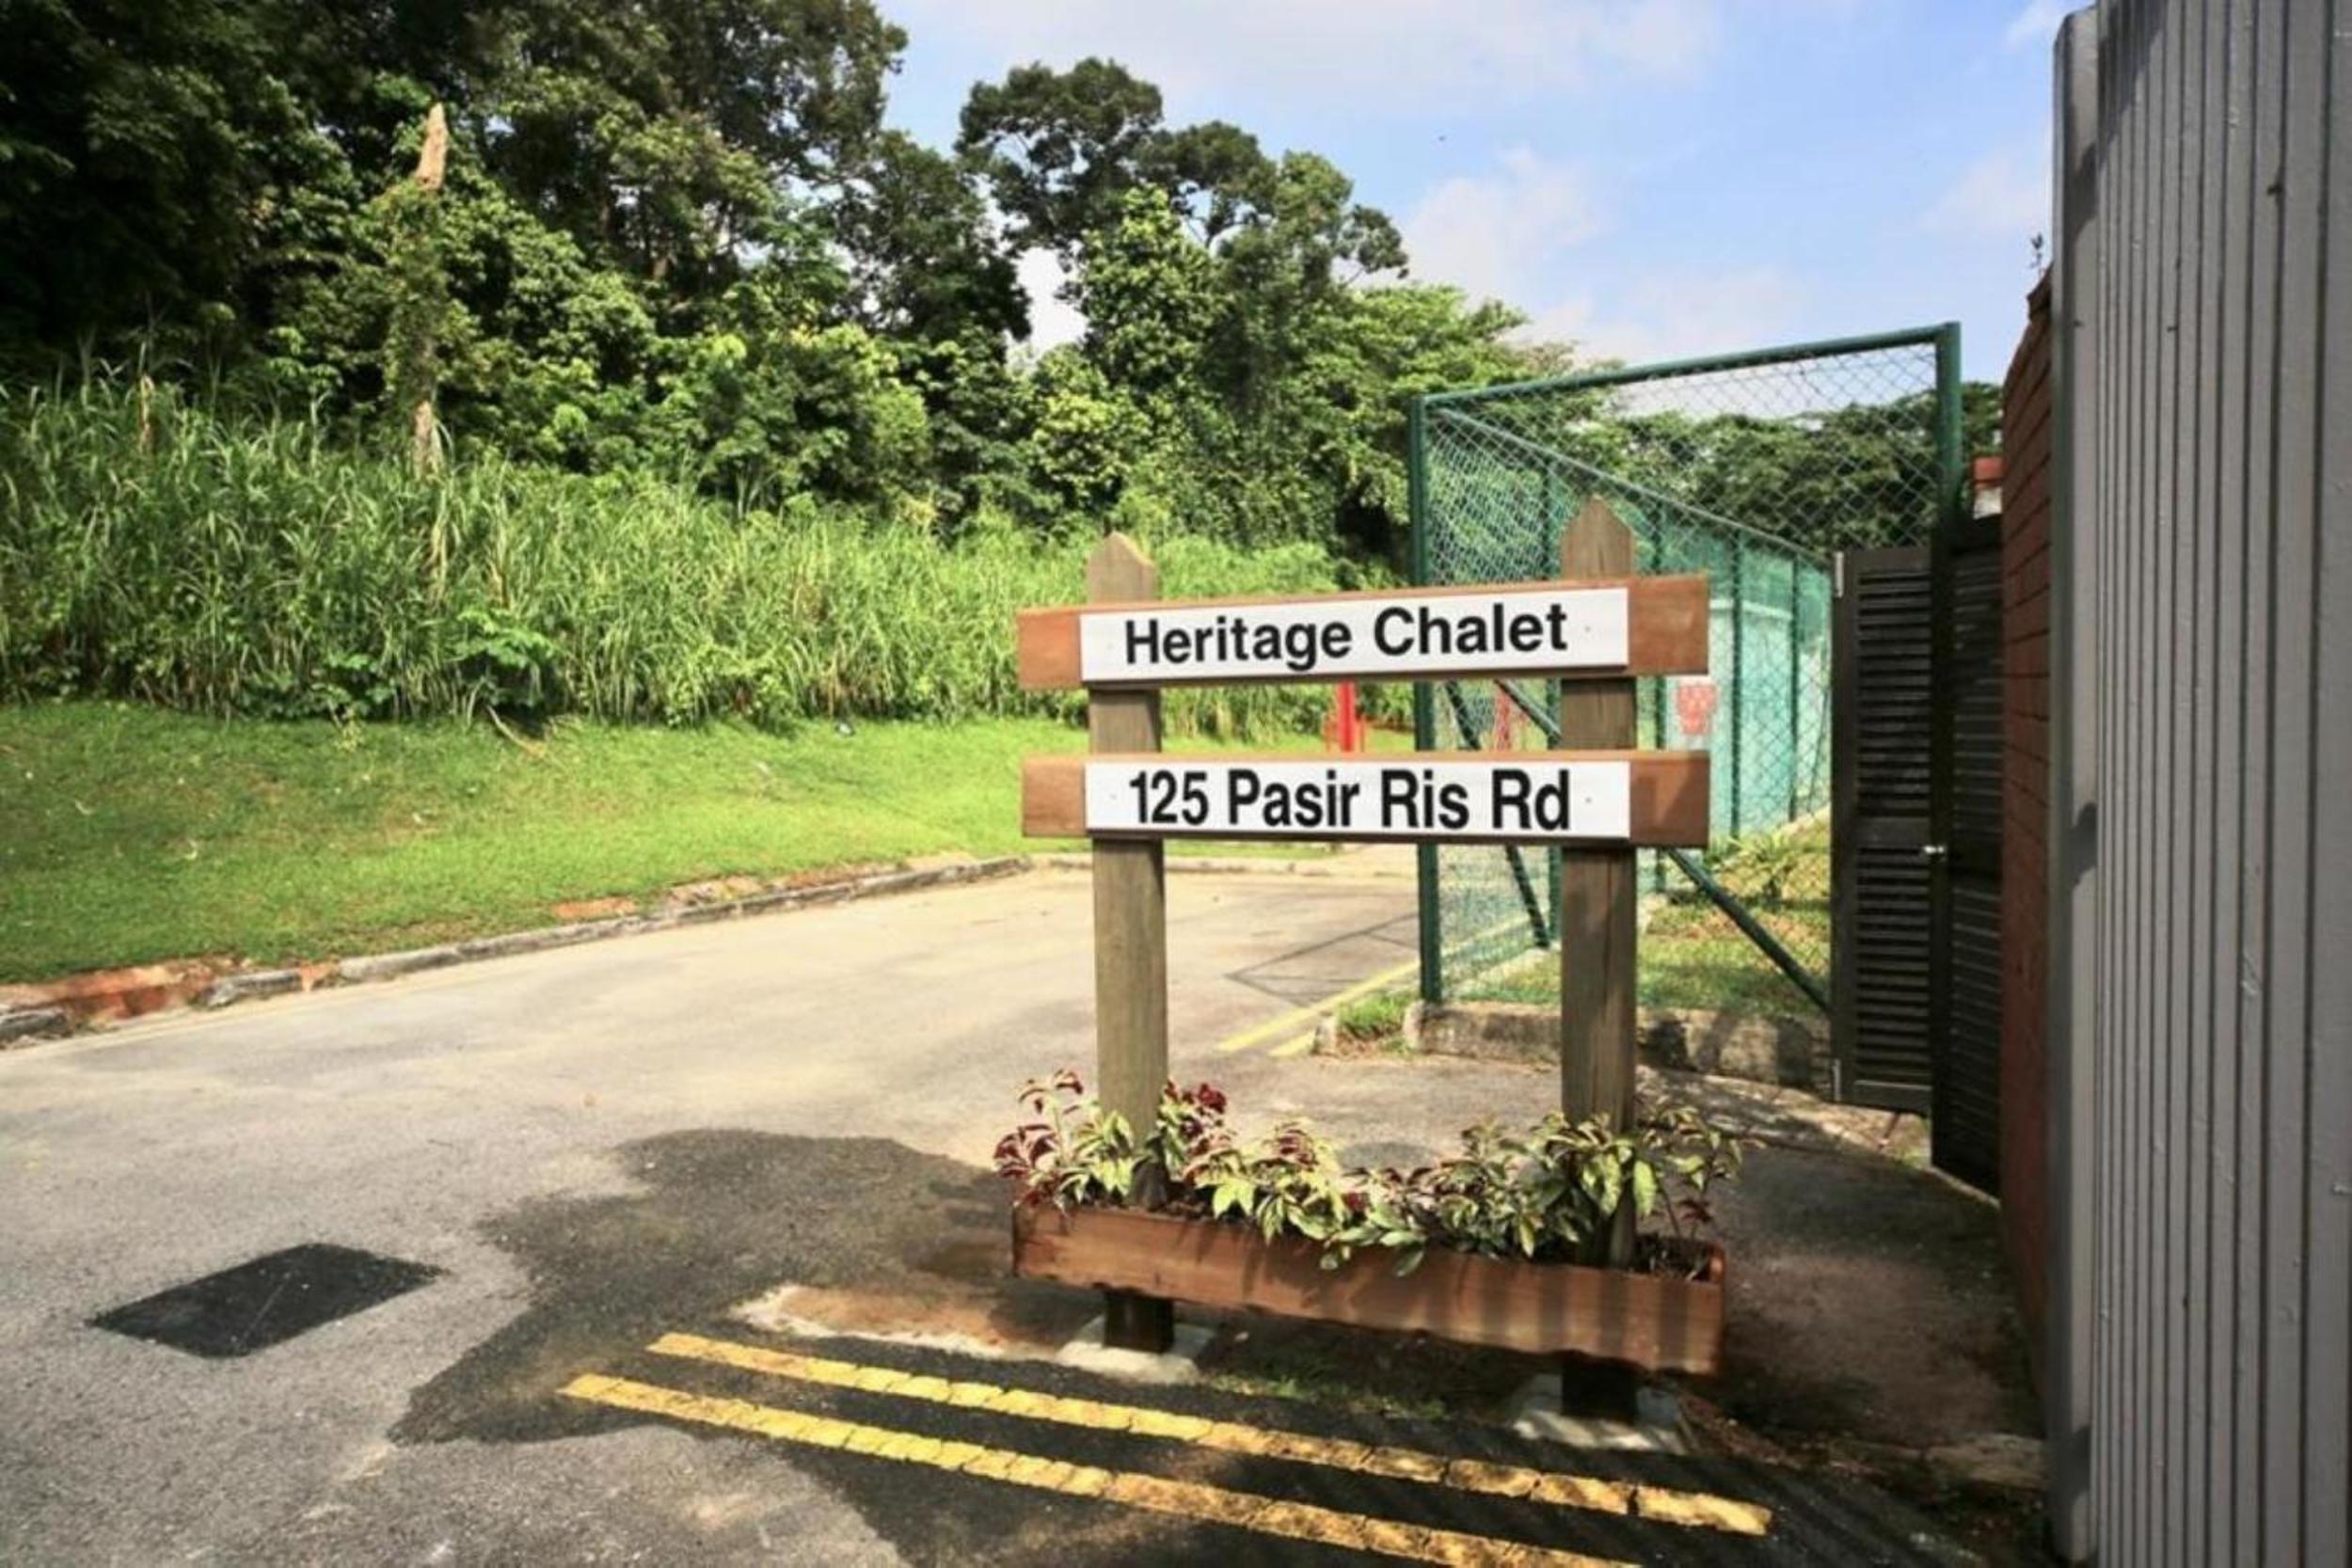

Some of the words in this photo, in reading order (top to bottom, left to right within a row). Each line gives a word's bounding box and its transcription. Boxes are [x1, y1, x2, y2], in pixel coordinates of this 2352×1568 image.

[1126, 615, 1352, 673] Heritage
[1374, 603, 1567, 657] Chalet
[1130, 769, 1209, 826] 125
[1228, 768, 1360, 828] Pasir
[1381, 769, 1470, 830] Ris
[1492, 768, 1569, 832] Rd
